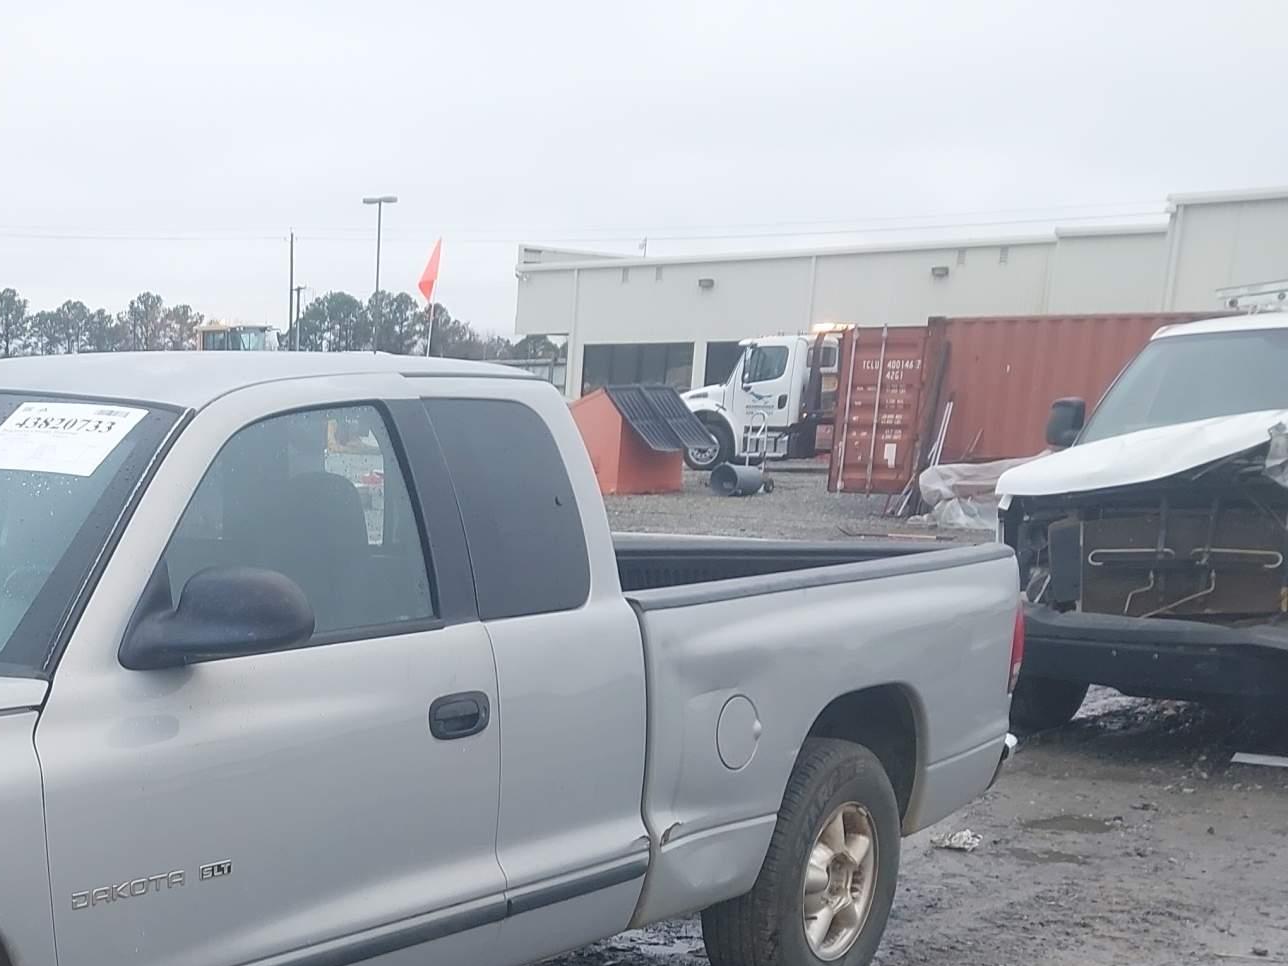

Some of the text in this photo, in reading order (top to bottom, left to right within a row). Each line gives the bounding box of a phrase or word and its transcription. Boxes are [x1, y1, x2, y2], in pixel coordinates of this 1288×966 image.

[15, 416, 117, 433] 43820733
[71, 859, 233, 911] DAKOTA SLT
